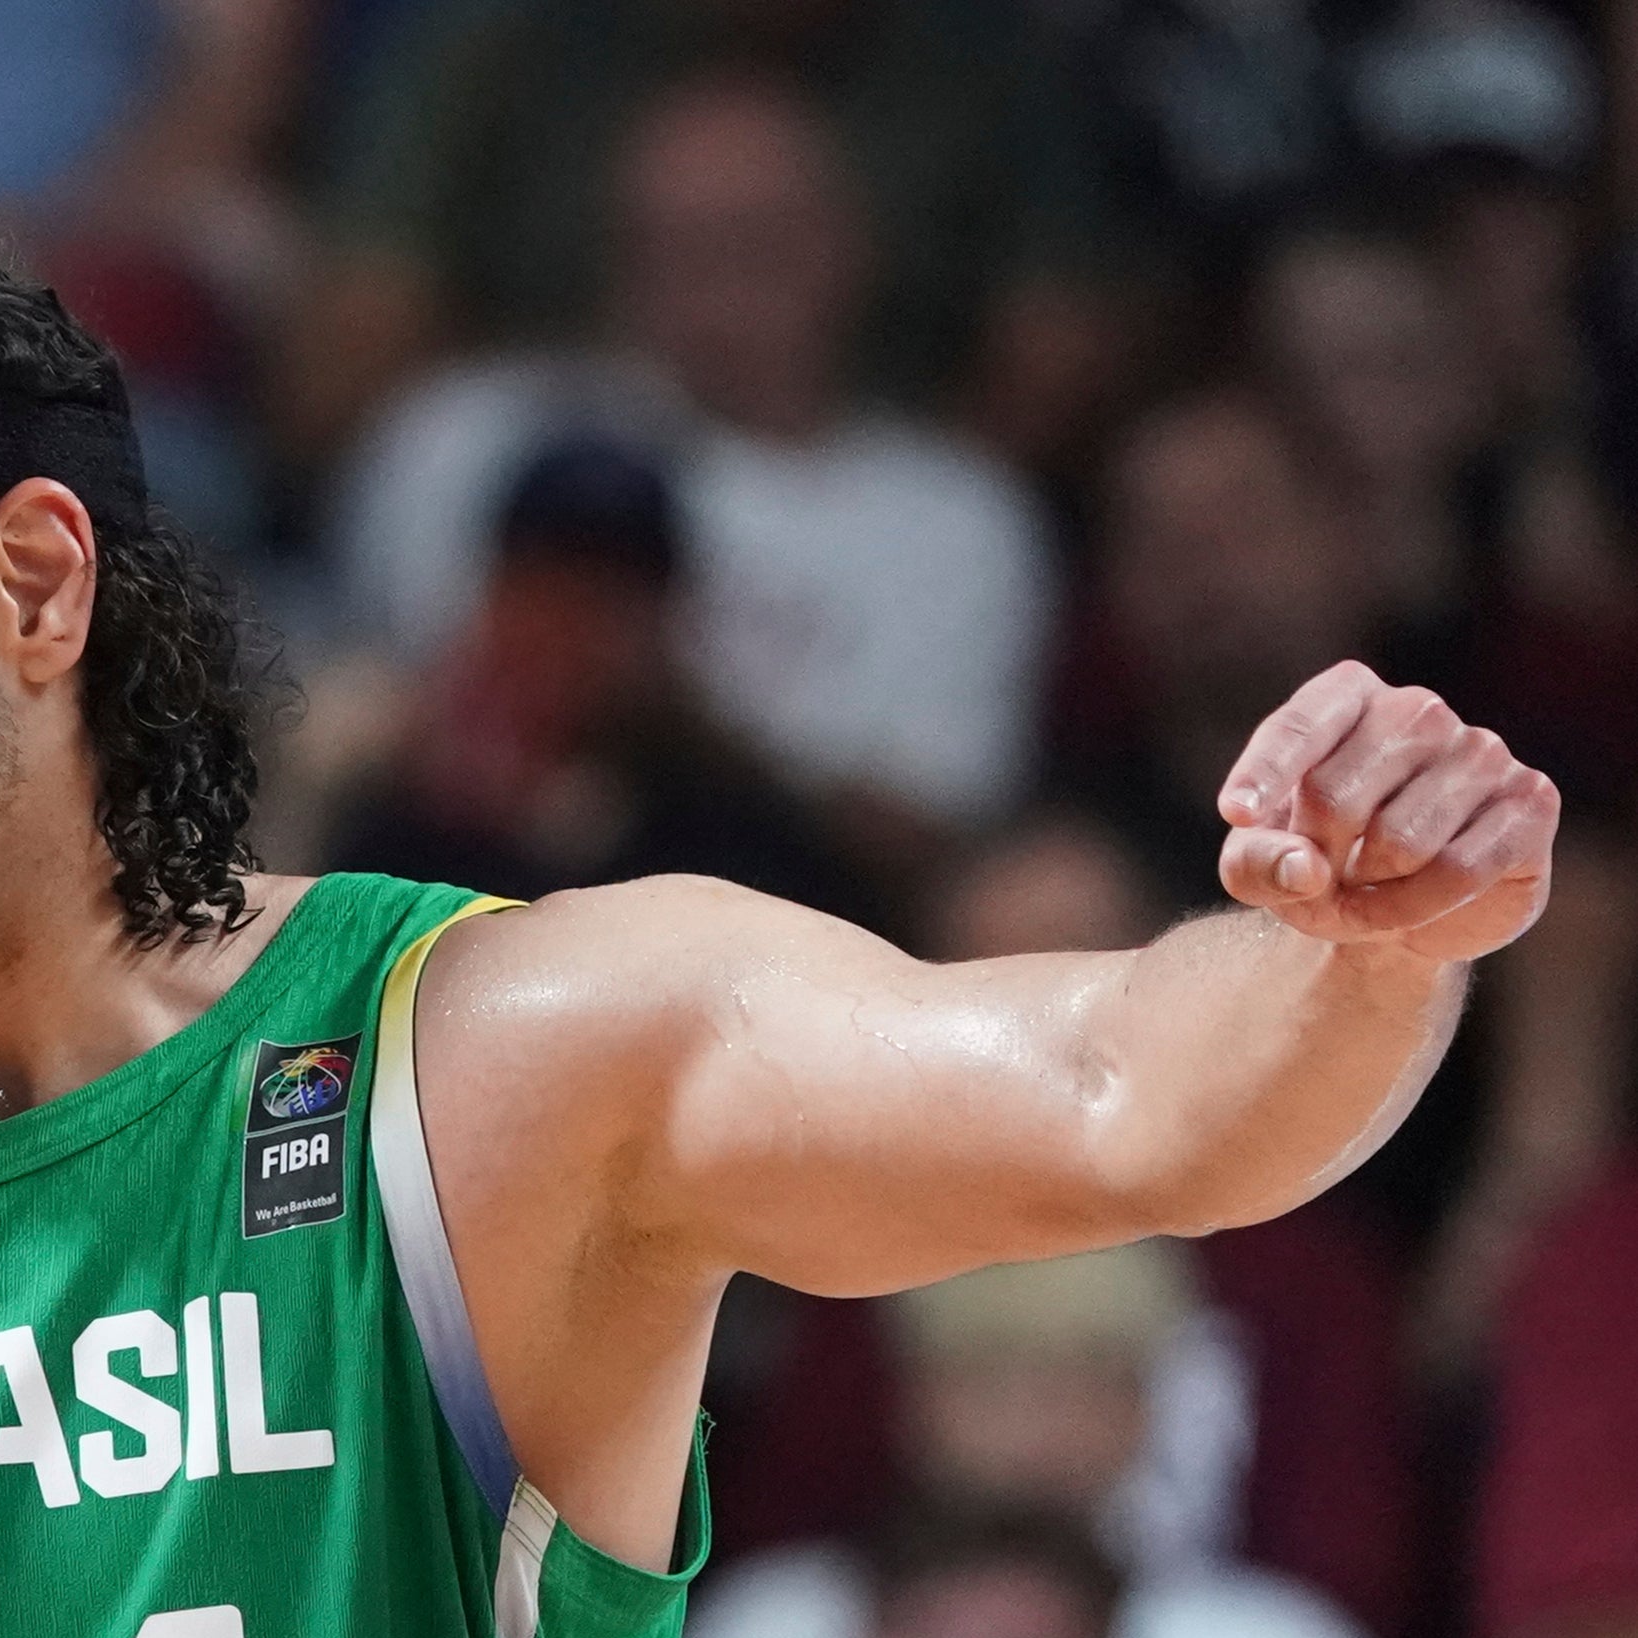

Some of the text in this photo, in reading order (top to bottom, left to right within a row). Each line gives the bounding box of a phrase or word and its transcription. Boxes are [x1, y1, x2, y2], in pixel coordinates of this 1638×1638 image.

[261, 1132, 330, 1180] FIBA
[255, 1192, 338, 1221] We Are Basketball
